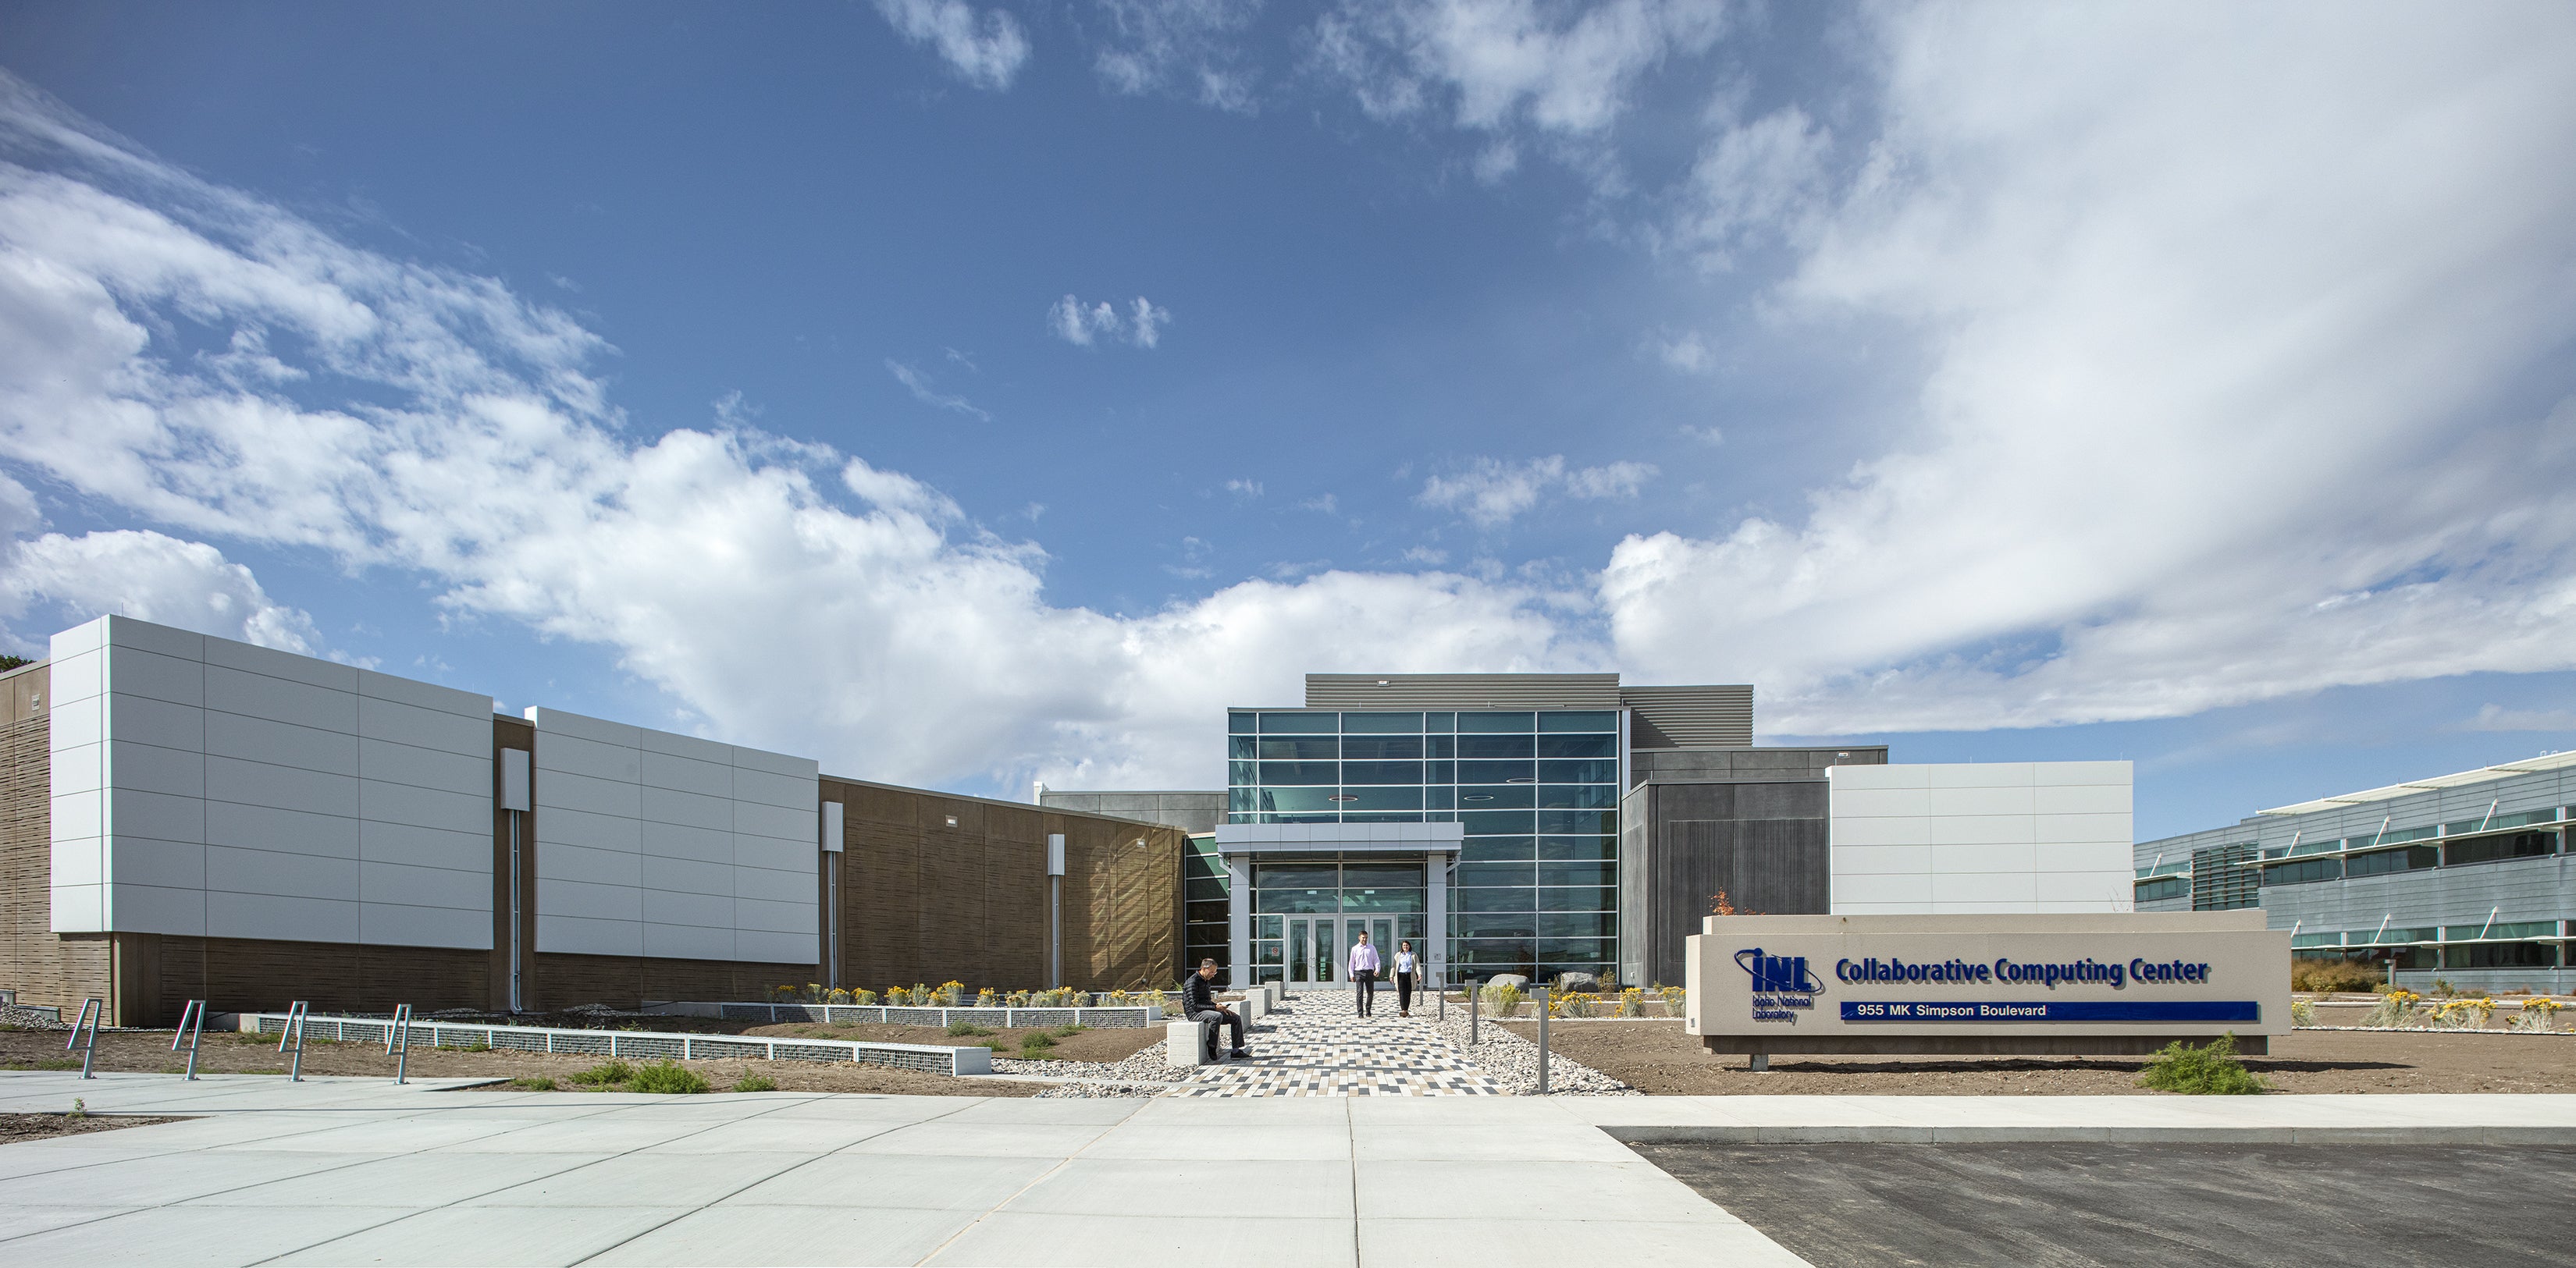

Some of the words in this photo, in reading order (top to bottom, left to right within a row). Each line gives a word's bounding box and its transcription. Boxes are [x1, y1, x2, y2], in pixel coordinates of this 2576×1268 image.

[1836, 958, 1988, 980] Collaborative
[1994, 958, 2123, 986] Computing
[2129, 958, 2208, 980] Center
[1752, 994, 1775, 1007] Idaho
[1777, 994, 1811, 1007] National
[1752, 1007, 1794, 1022] Laboratory
[1858, 1004, 1884, 1015] 955
[1890, 1004, 1911, 1015] MK
[1916, 1004, 1973, 1018] Simpson
[1980, 1005, 2046, 1015] Boulevard
